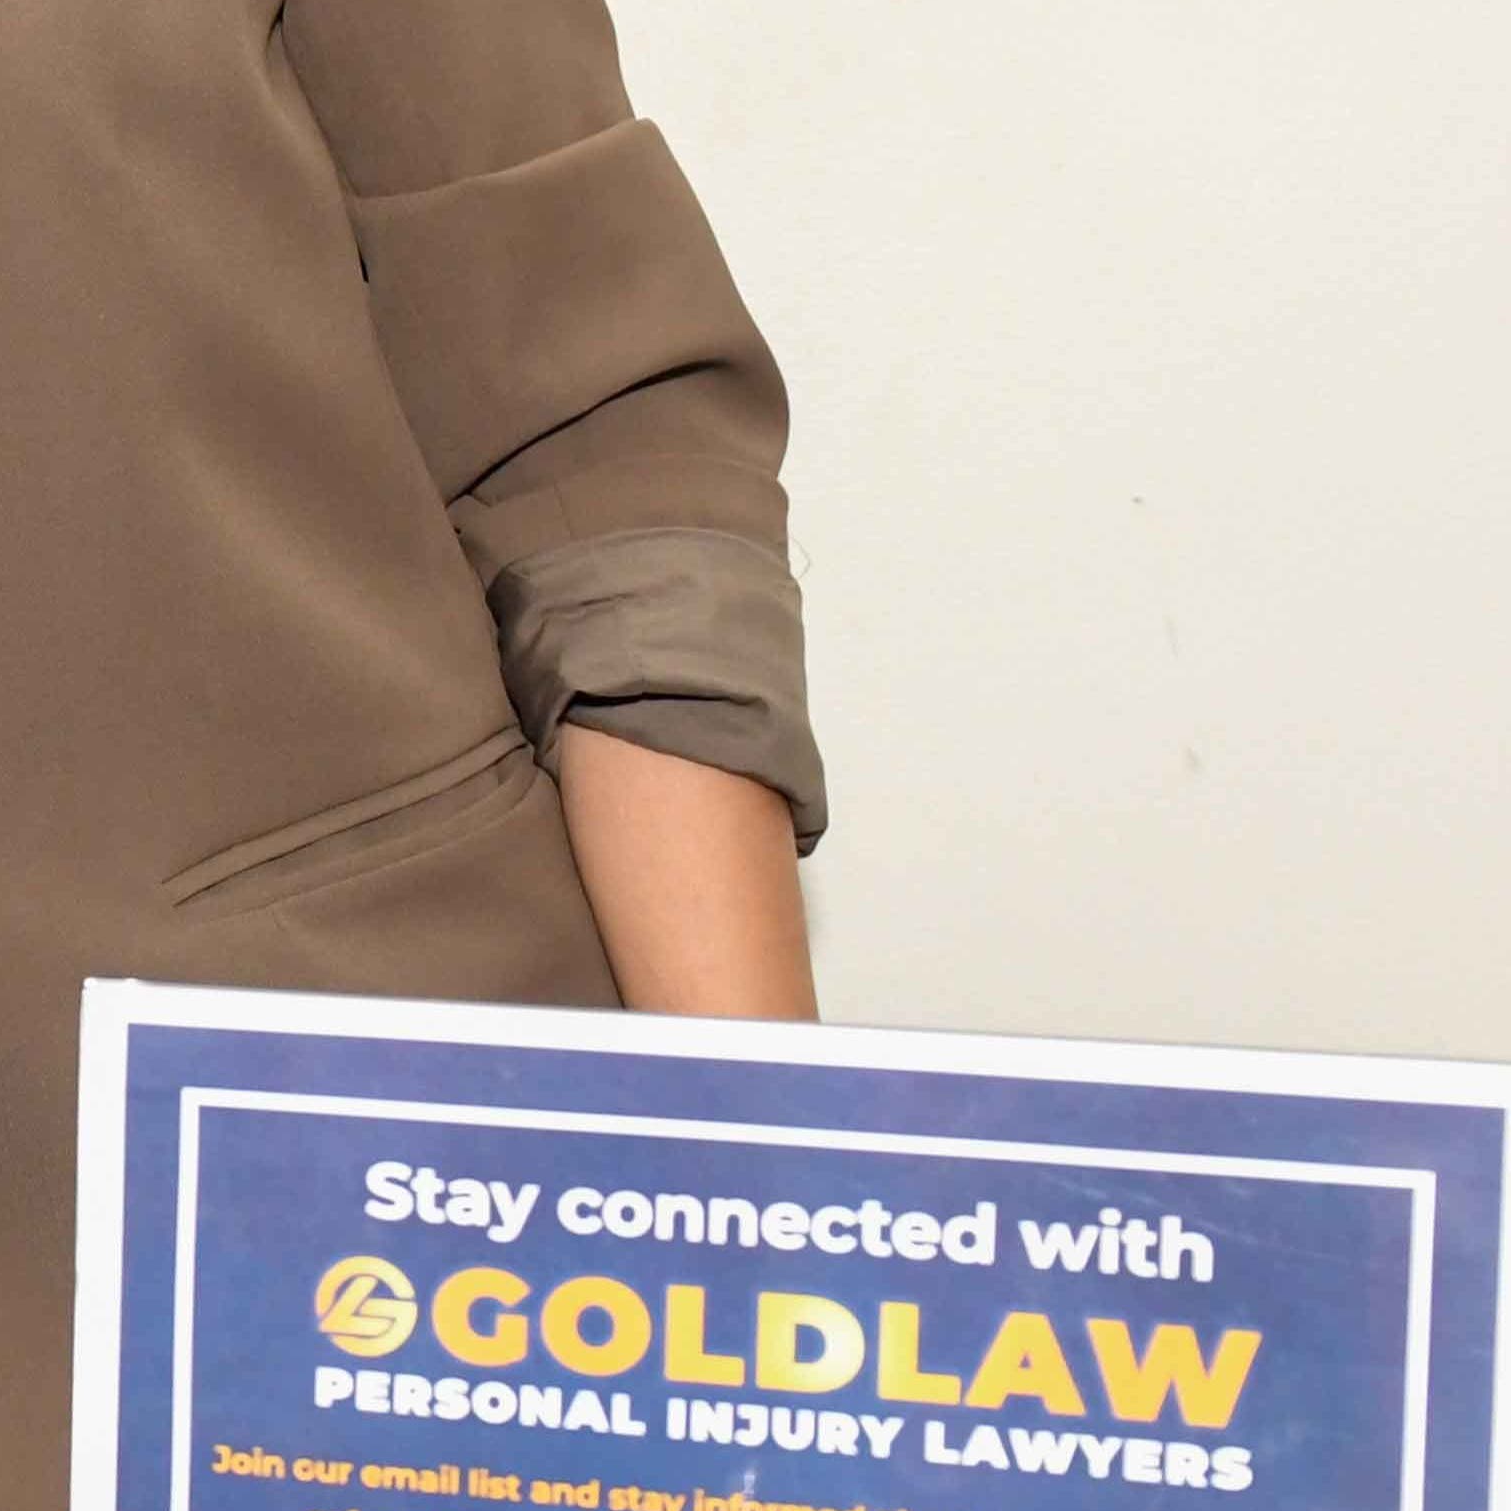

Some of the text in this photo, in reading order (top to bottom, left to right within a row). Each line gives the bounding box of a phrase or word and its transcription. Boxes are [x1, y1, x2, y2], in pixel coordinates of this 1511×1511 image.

[364, 1161, 1214, 1282] Stay connected with
[431, 1265, 1262, 1432] GOLDLAW
[212, 1444, 287, 1478] Join
[292, 1458, 353, 1485] our
[360, 1464, 461, 1494] email
[468, 1468, 522, 1502] list
[530, 1480, 601, 1509] and
[314, 1366, 1253, 1492] PERSONAL INJURY LAWYERS
